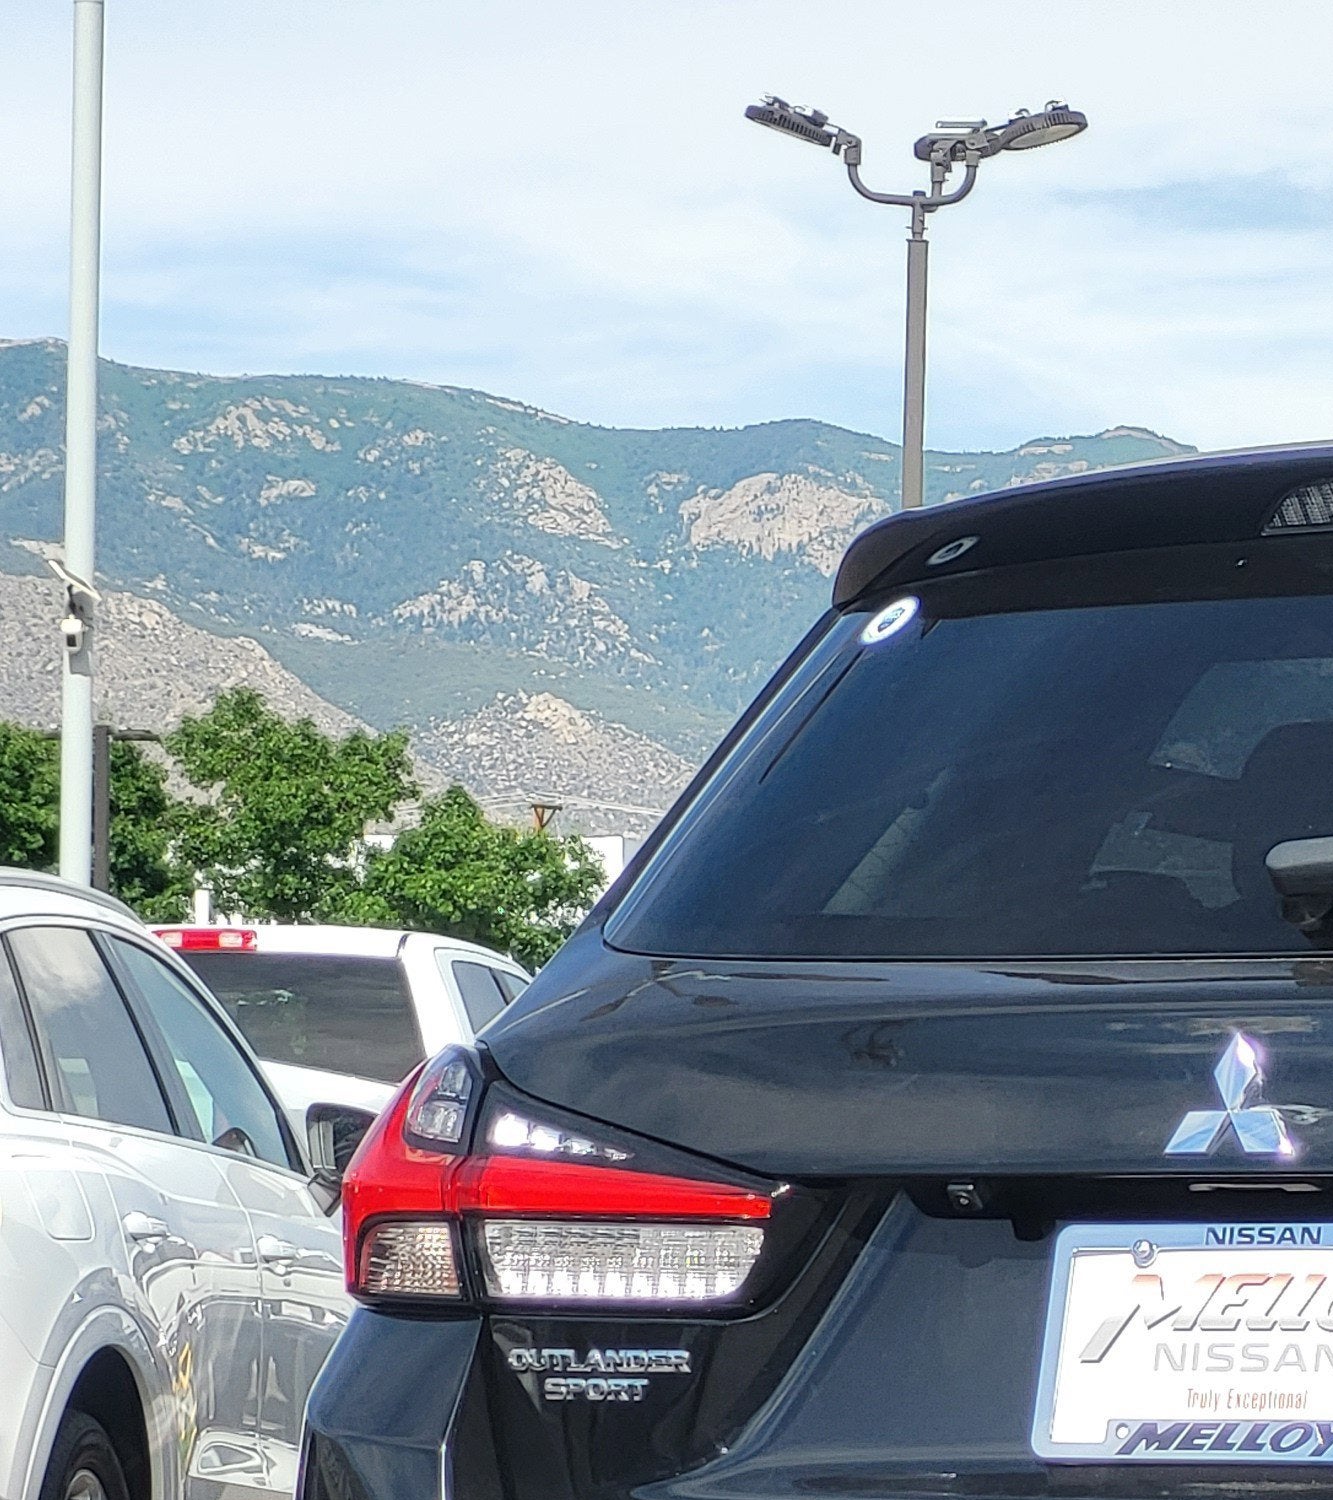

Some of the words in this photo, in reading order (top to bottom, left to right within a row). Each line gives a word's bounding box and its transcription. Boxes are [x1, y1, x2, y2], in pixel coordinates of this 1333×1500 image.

[1204, 1226, 1322, 1246] NISSAN
[508, 1348, 692, 1374] OUTLANDER
[543, 1377, 649, 1402] SPORT
[1186, 1387, 1221, 1411] Truly
[1226, 1387, 1309, 1413] Exceptional
